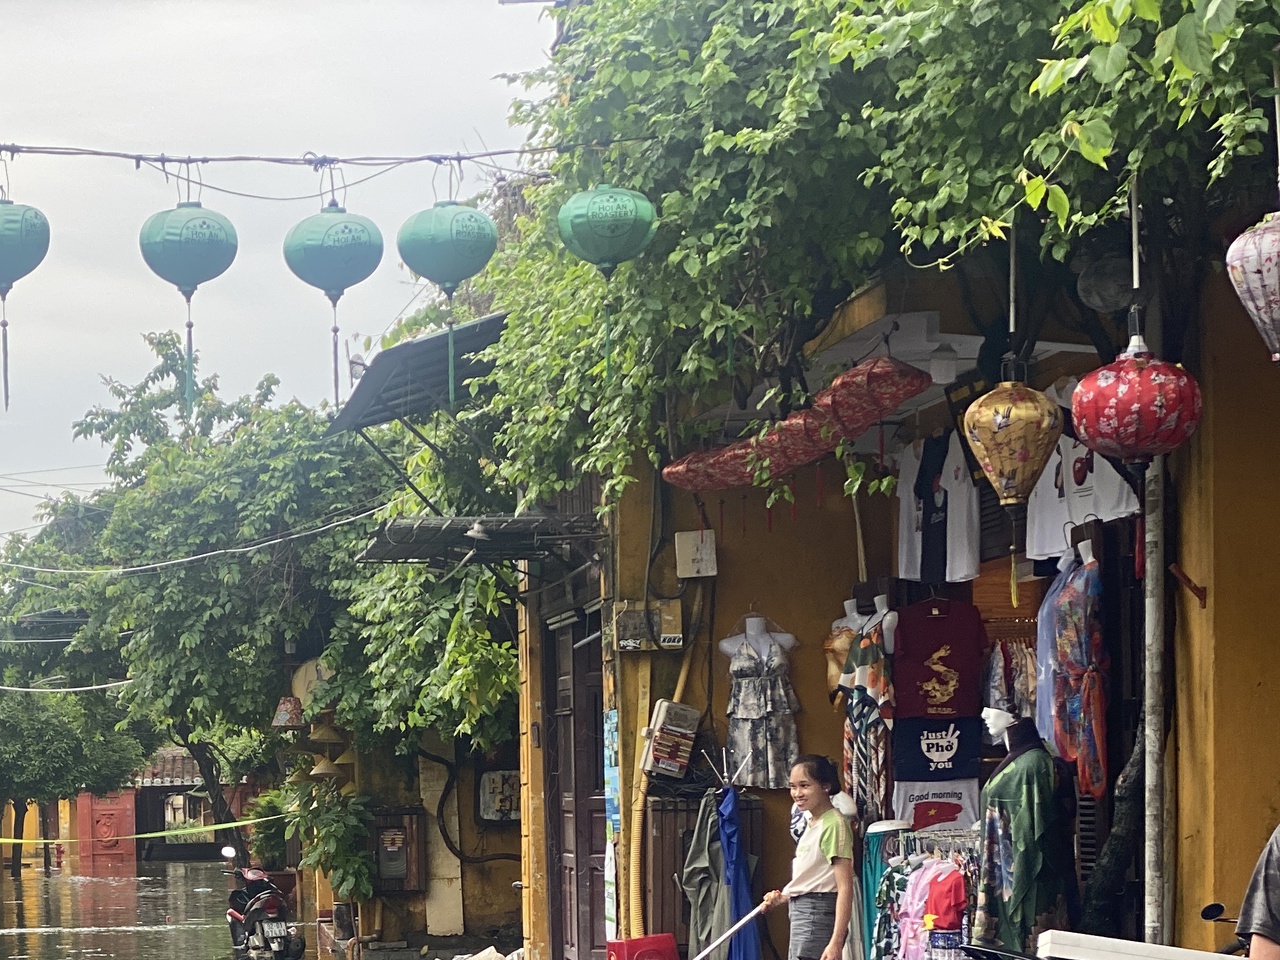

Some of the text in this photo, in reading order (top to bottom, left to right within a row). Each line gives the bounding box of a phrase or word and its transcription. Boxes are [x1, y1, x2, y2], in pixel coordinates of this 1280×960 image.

[598, 203, 628, 212] HOI AN
[591, 209, 634, 219] ROASTERY
[191, 230, 220, 239] HOI AN
[332, 234, 362, 245] HOI AN
[920, 730, 947, 740] Just
[925, 740, 954, 753] Phở
[929, 761, 953, 771] you
[908, 789, 963, 803] Good morning
